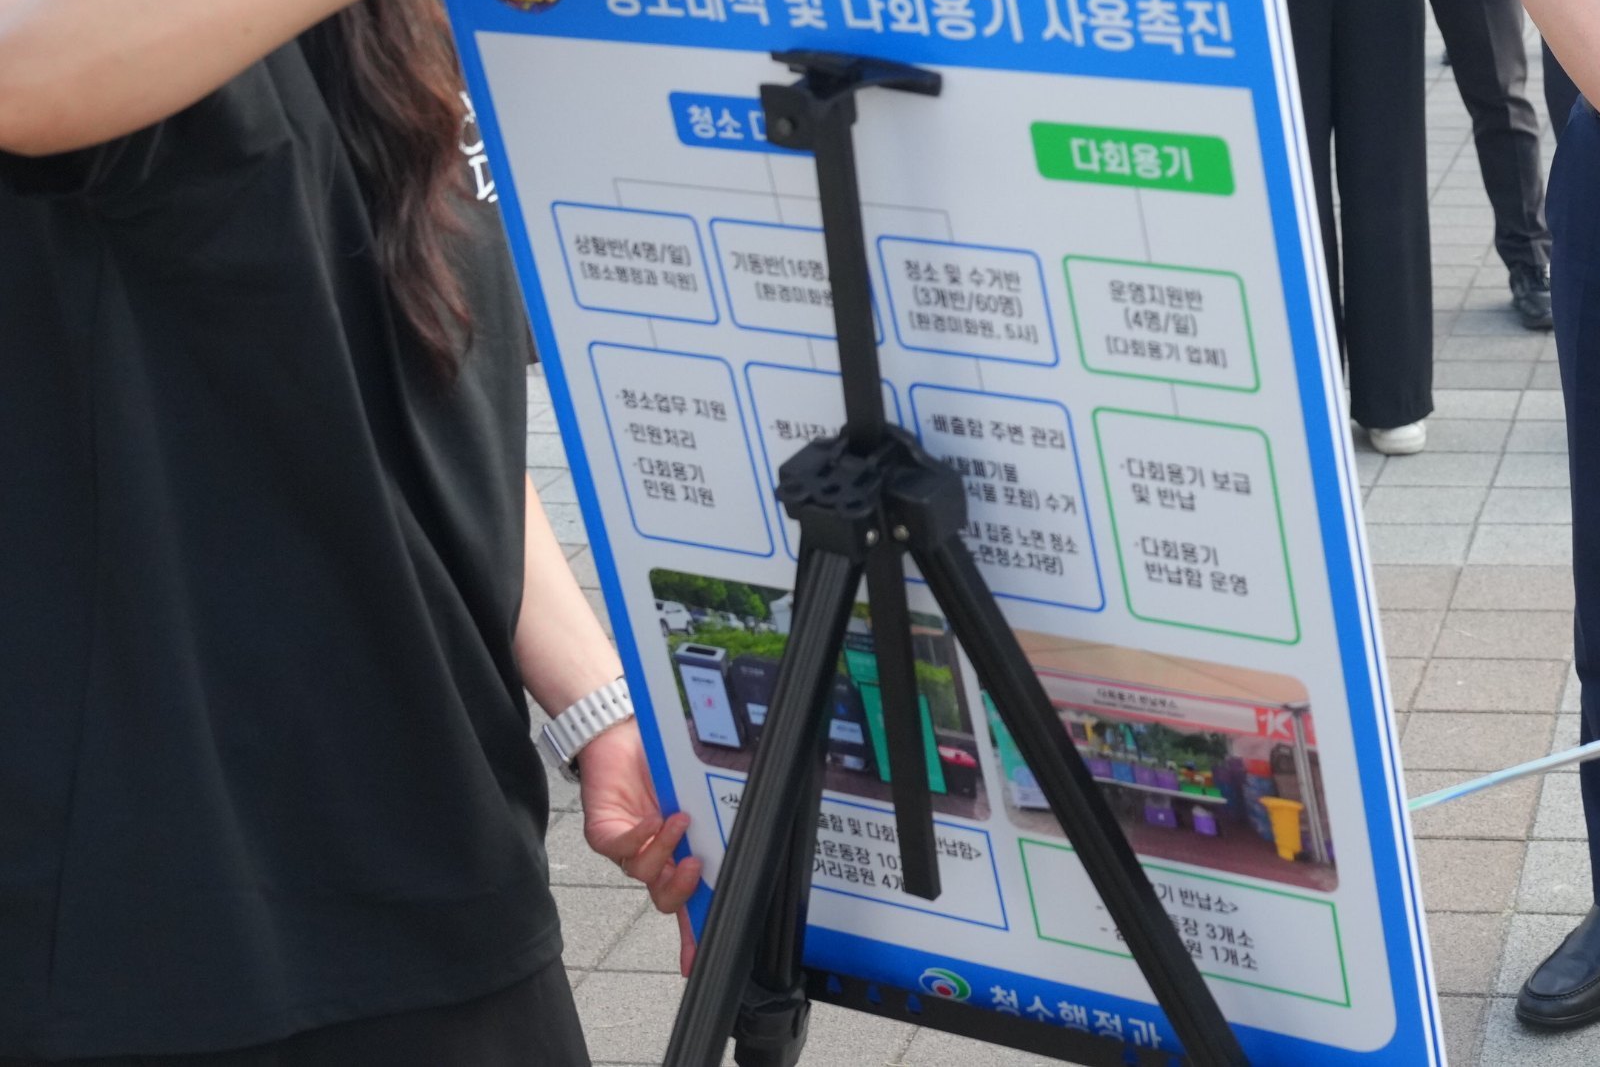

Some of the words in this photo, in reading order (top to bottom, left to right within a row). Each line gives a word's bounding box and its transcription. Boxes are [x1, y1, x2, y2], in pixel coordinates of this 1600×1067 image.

[687, 104, 744, 140] 청소
[1069, 137, 1194, 182] 다회용기
[904, 260, 940, 284] 청소
[946, 264, 963, 287] 및
[969, 267, 1022, 293] 수거반
[1108, 280, 1204, 312] 운영지원반
[1123, 307, 1199, 338] (4명/일)
[692, 398, 728, 422] 지원
[990, 420, 1025, 446] 주변
[1030, 426, 1066, 450] 관리
[643, 479, 677, 503] 민원
[681, 484, 716, 509] 지원
[1132, 482, 1151, 506] 및
[1157, 485, 1197, 513] 반납
[1212, 469, 1252, 496] 보급
[1003, 485, 1041, 511] 포함)
[1045, 492, 1078, 515] 수거
[984, 522, 1014, 546] 집중
[1018, 527, 1047, 551] 노면
[1050, 532, 1080, 555] 청소
[1144, 560, 1203, 590] 반납함
[1209, 570, 1249, 598] 운영
[847, 816, 863, 837] 및
[867, 821, 899, 844] 다회
[1205, 921, 1255, 949] 3개소
[1211, 944, 1259, 971] 1개소
